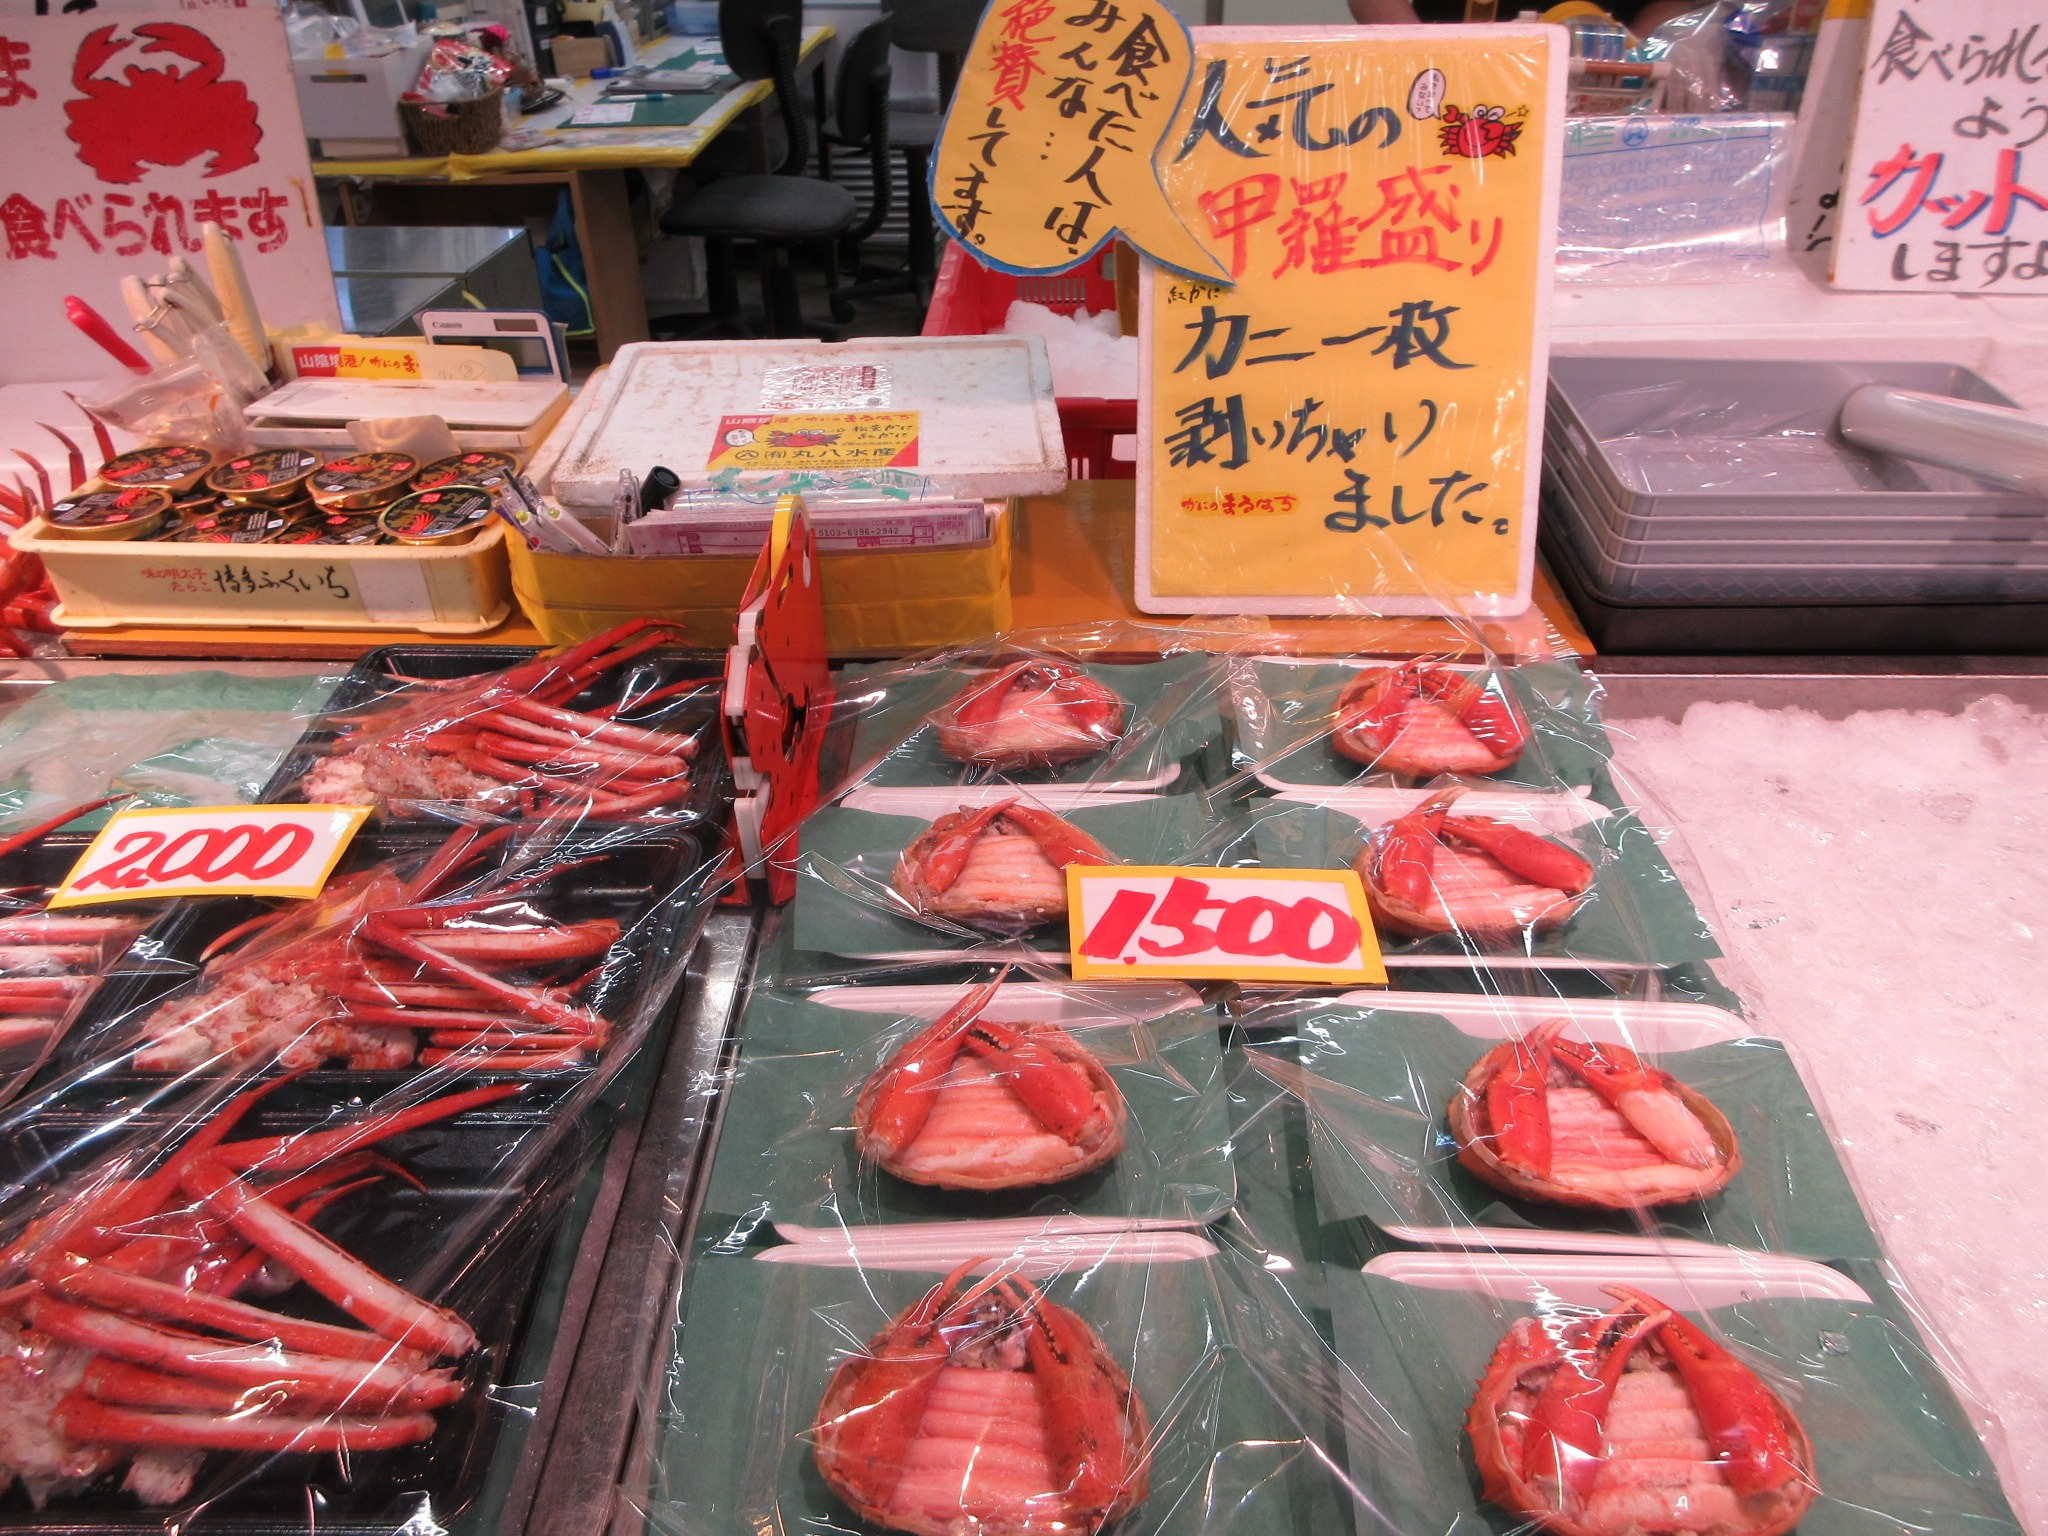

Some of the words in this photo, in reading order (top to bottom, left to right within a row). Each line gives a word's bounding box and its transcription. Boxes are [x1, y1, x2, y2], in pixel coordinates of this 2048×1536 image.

[1172, 57, 1401, 162] 人気の
[1953, 95, 2048, 149] よう
[0, 187, 289, 260] 食べられます
[1197, 164, 1504, 279] 甲羅盛り
[1857, 142, 2048, 240] カット
[432, 321, 463, 329] Canon
[1166, 284, 1222, 305] 紅かに
[1171, 299, 1478, 380] カニ一枚
[1163, 393, 1438, 471] 剥いちゃい
[818, 527, 899, 538] 5103-6396-2942
[1181, 493, 1298, 516] かにのまるはち
[1324, 468, 1510, 535] ました。
